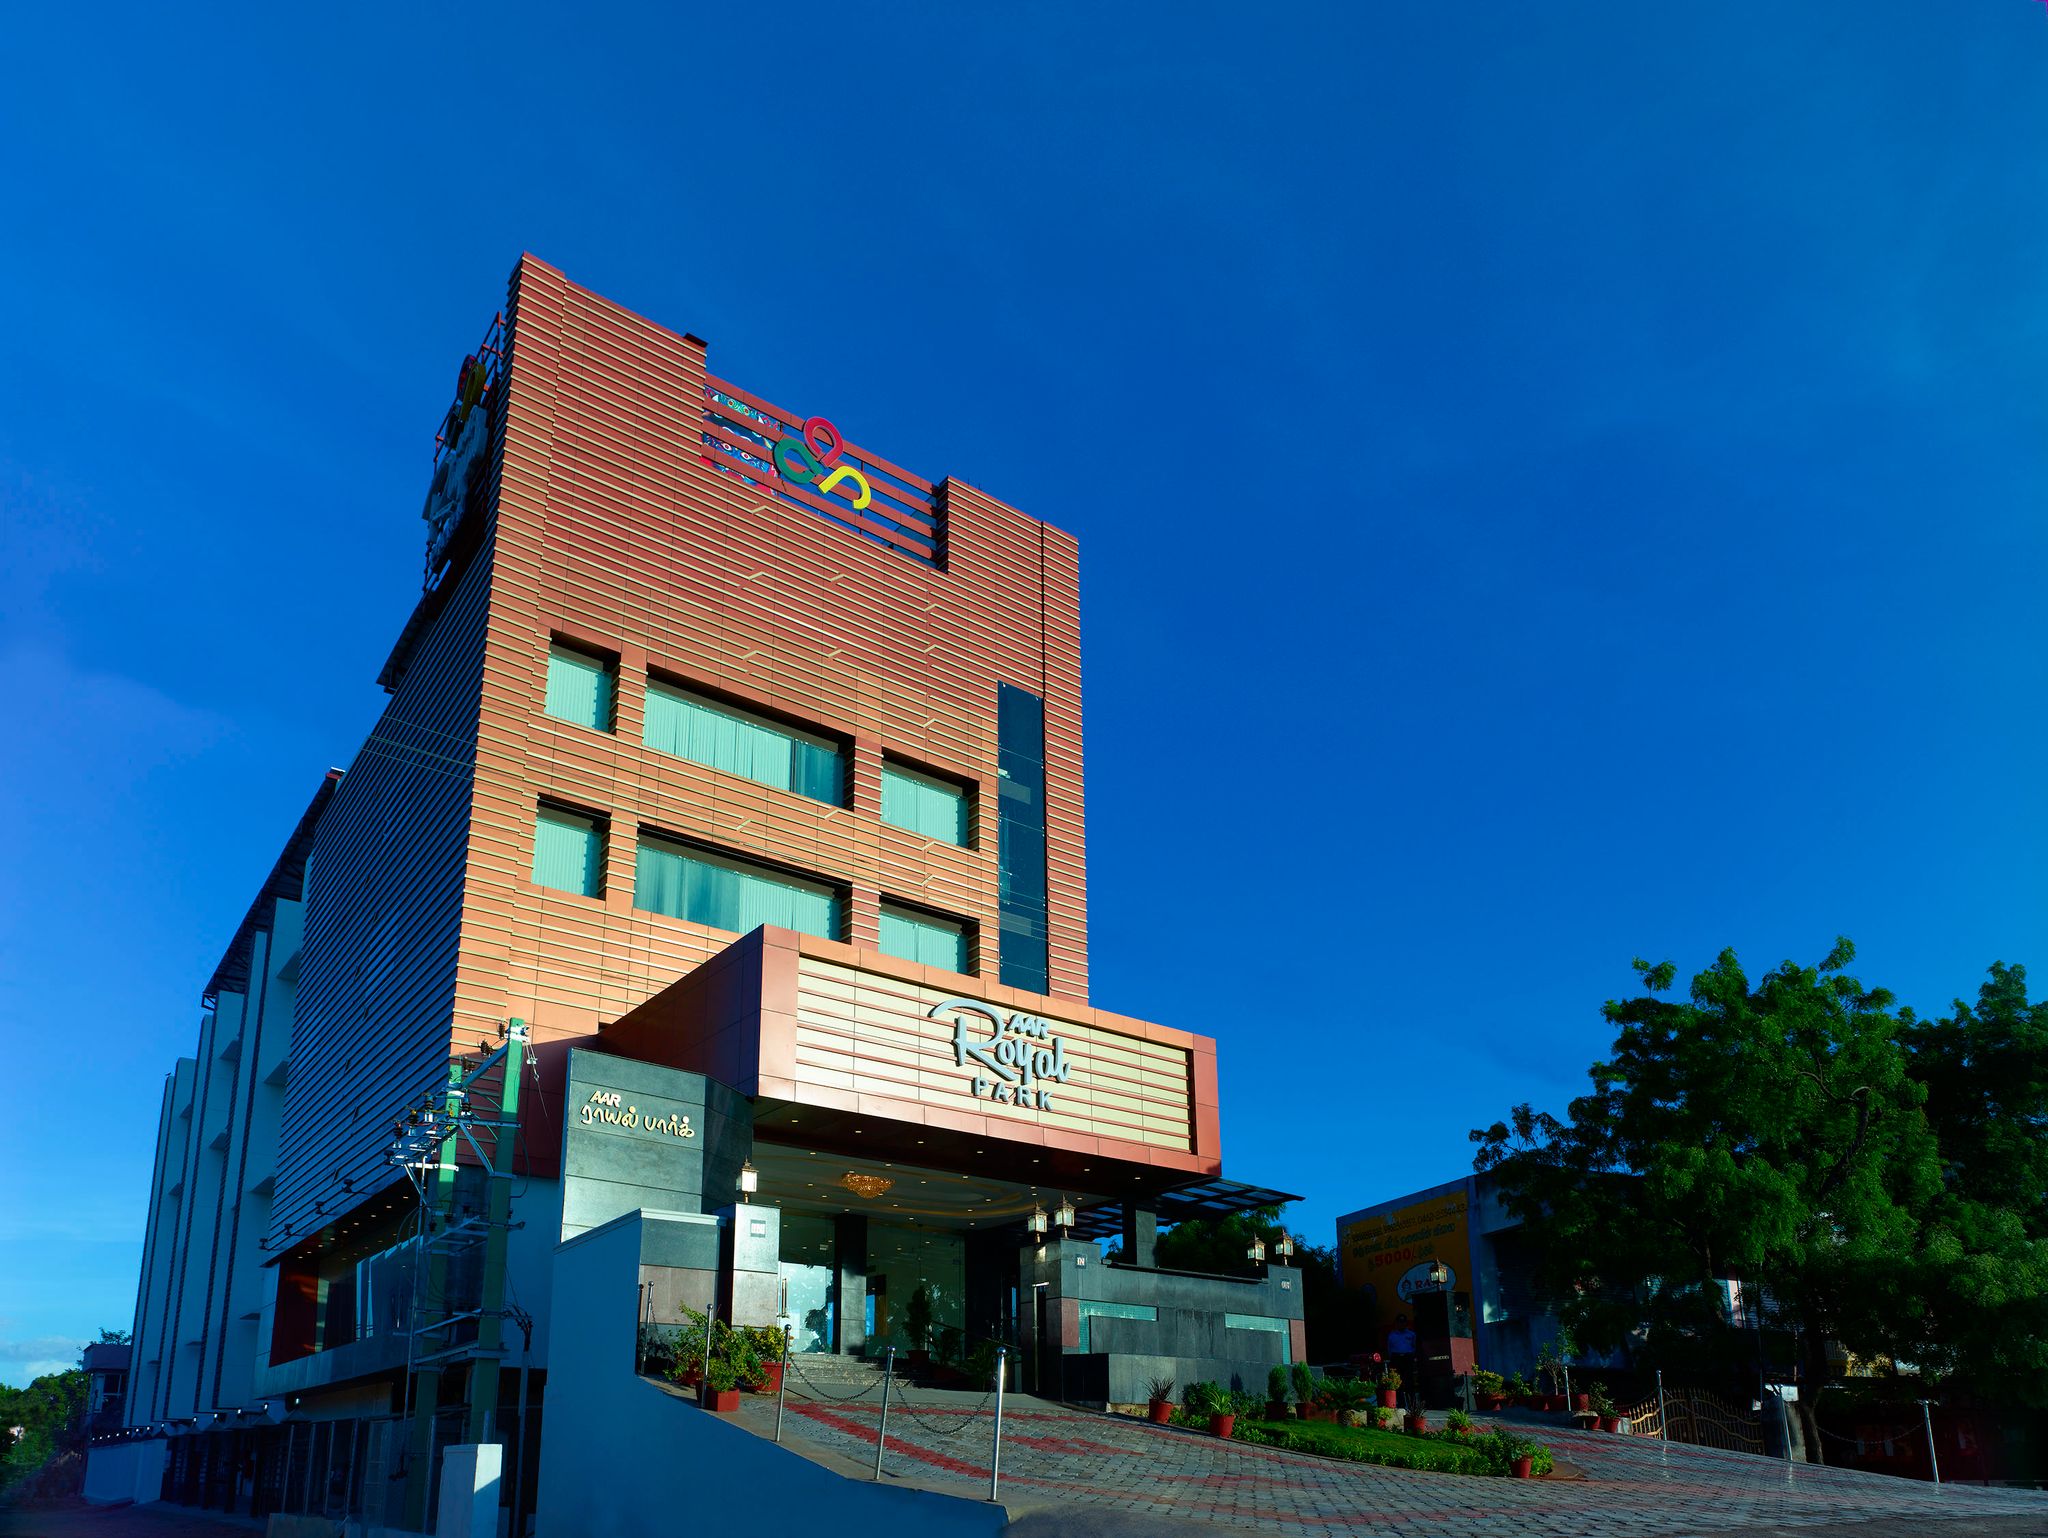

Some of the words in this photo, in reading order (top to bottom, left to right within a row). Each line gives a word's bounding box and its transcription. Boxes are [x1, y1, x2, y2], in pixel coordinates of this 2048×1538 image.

[927, 998, 1071, 1085] Royal
[1004, 1013, 1050, 1040] AAR
[588, 1090, 622, 1108] AAR
[971, 1076, 1054, 1111] PARK
[580, 1104, 639, 1129] ராயல்
[643, 1113, 695, 1138] பார்க்
